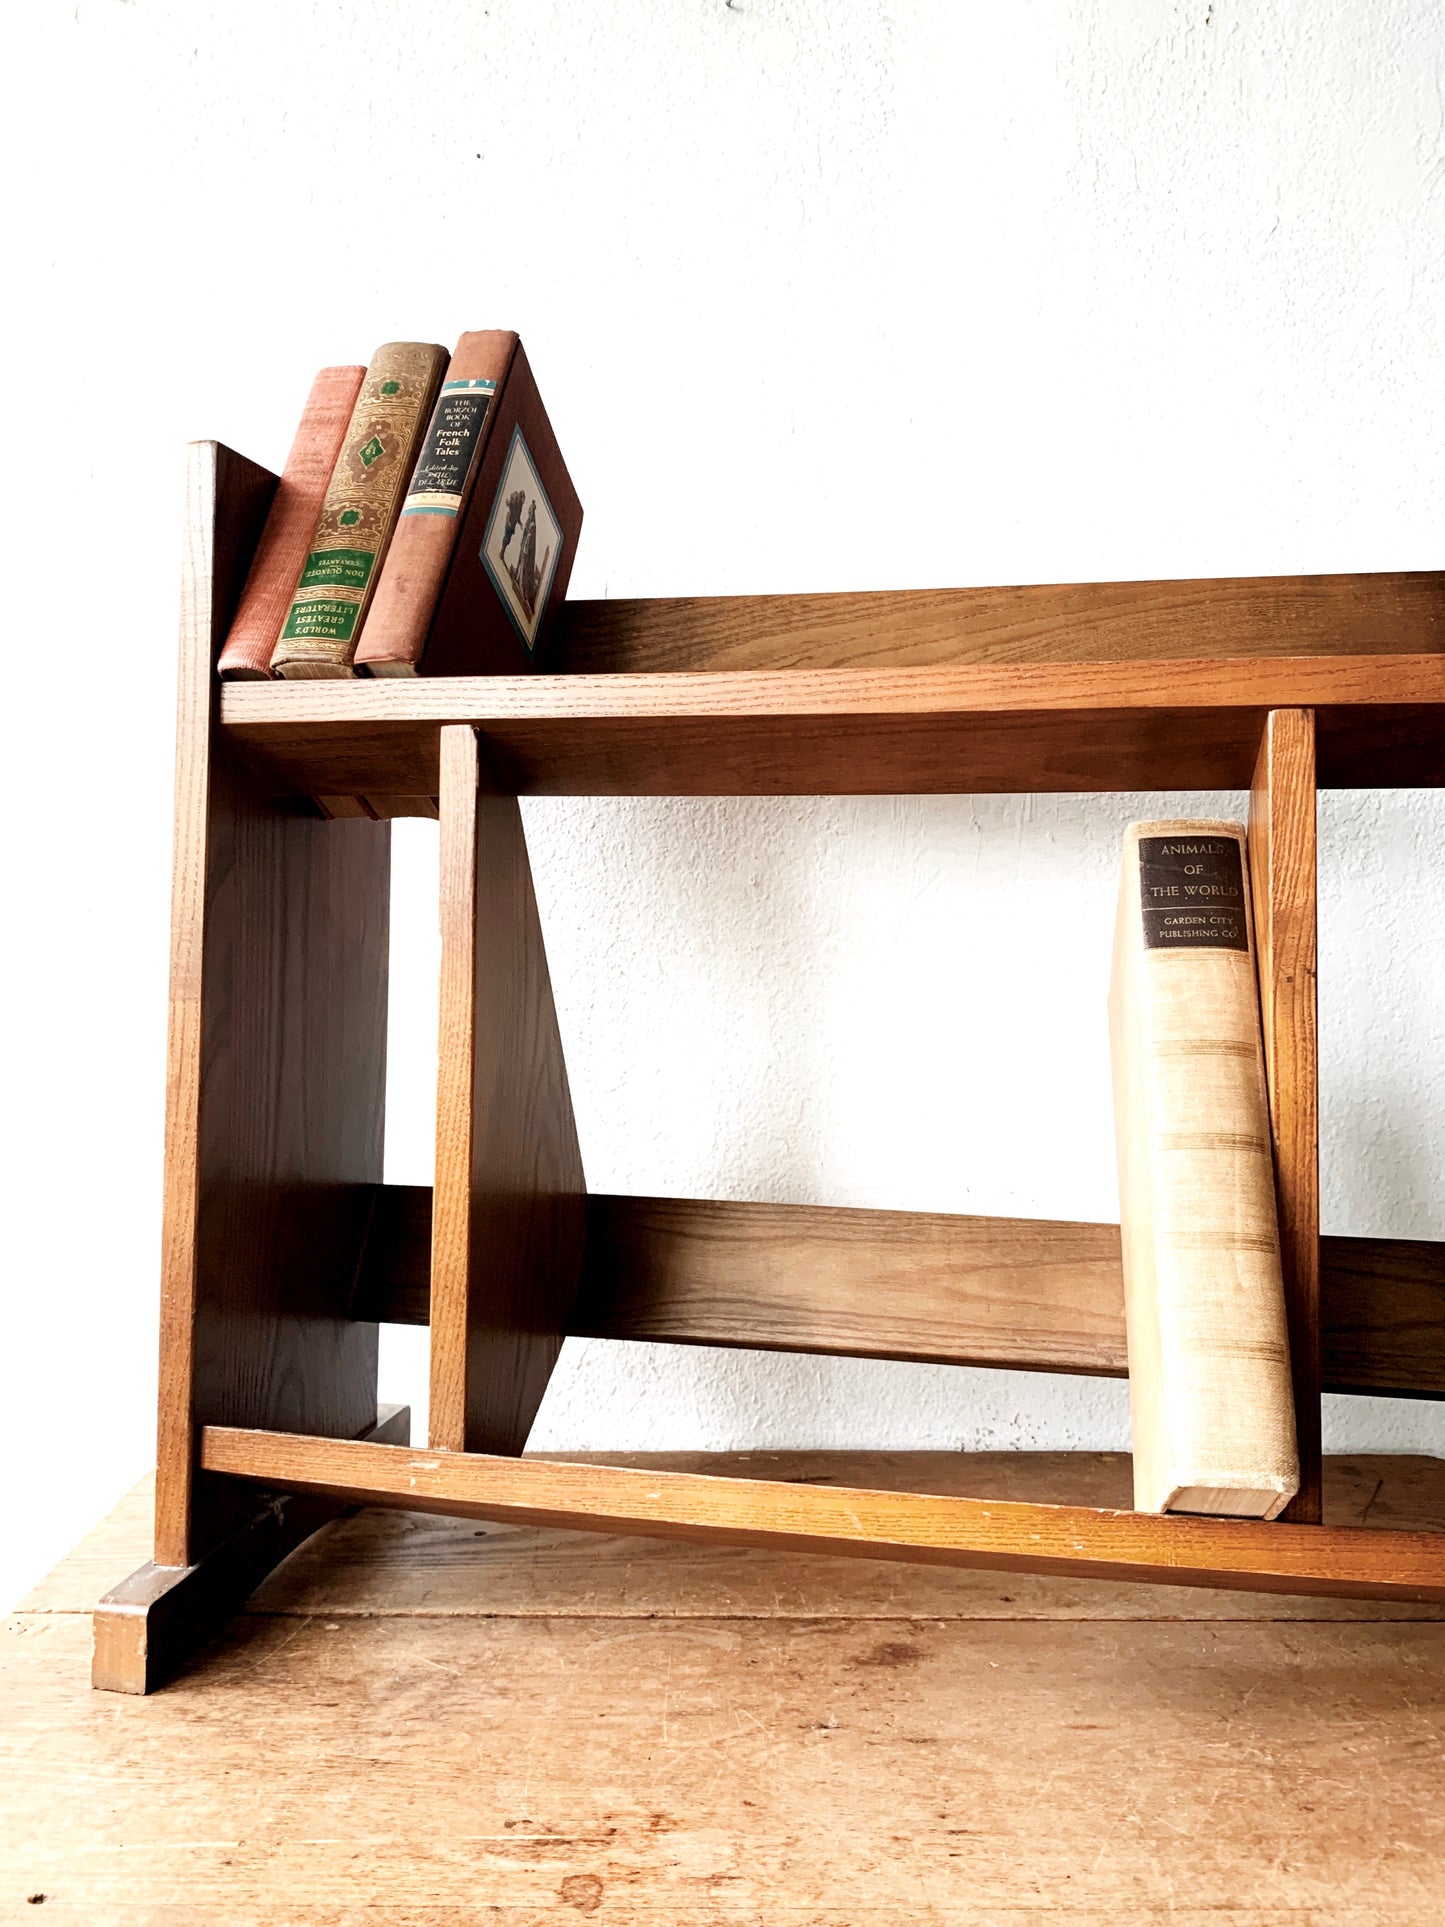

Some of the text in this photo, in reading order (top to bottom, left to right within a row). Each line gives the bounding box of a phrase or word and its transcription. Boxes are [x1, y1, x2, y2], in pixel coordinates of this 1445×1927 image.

[436, 429, 470, 437] French
[439, 438, 461, 446] Folk
[434, 447, 460, 456] Tales
[318, 559, 359, 567] CERVANTES
[305, 567, 365, 578] DON QUIXOTE
[294, 604, 354, 615] LITERATURE
[295, 615, 345, 625] GREATEST
[295, 627, 336, 635] WORLD'S
[1161, 844, 1225, 855] ANIMALS
[1183, 864, 1204, 875] OF
[1151, 885, 1239, 897] THE WORLD
[1164, 916, 1234, 925] GARDEN CITY
[1159, 929, 1219, 938] PUBLISHING
